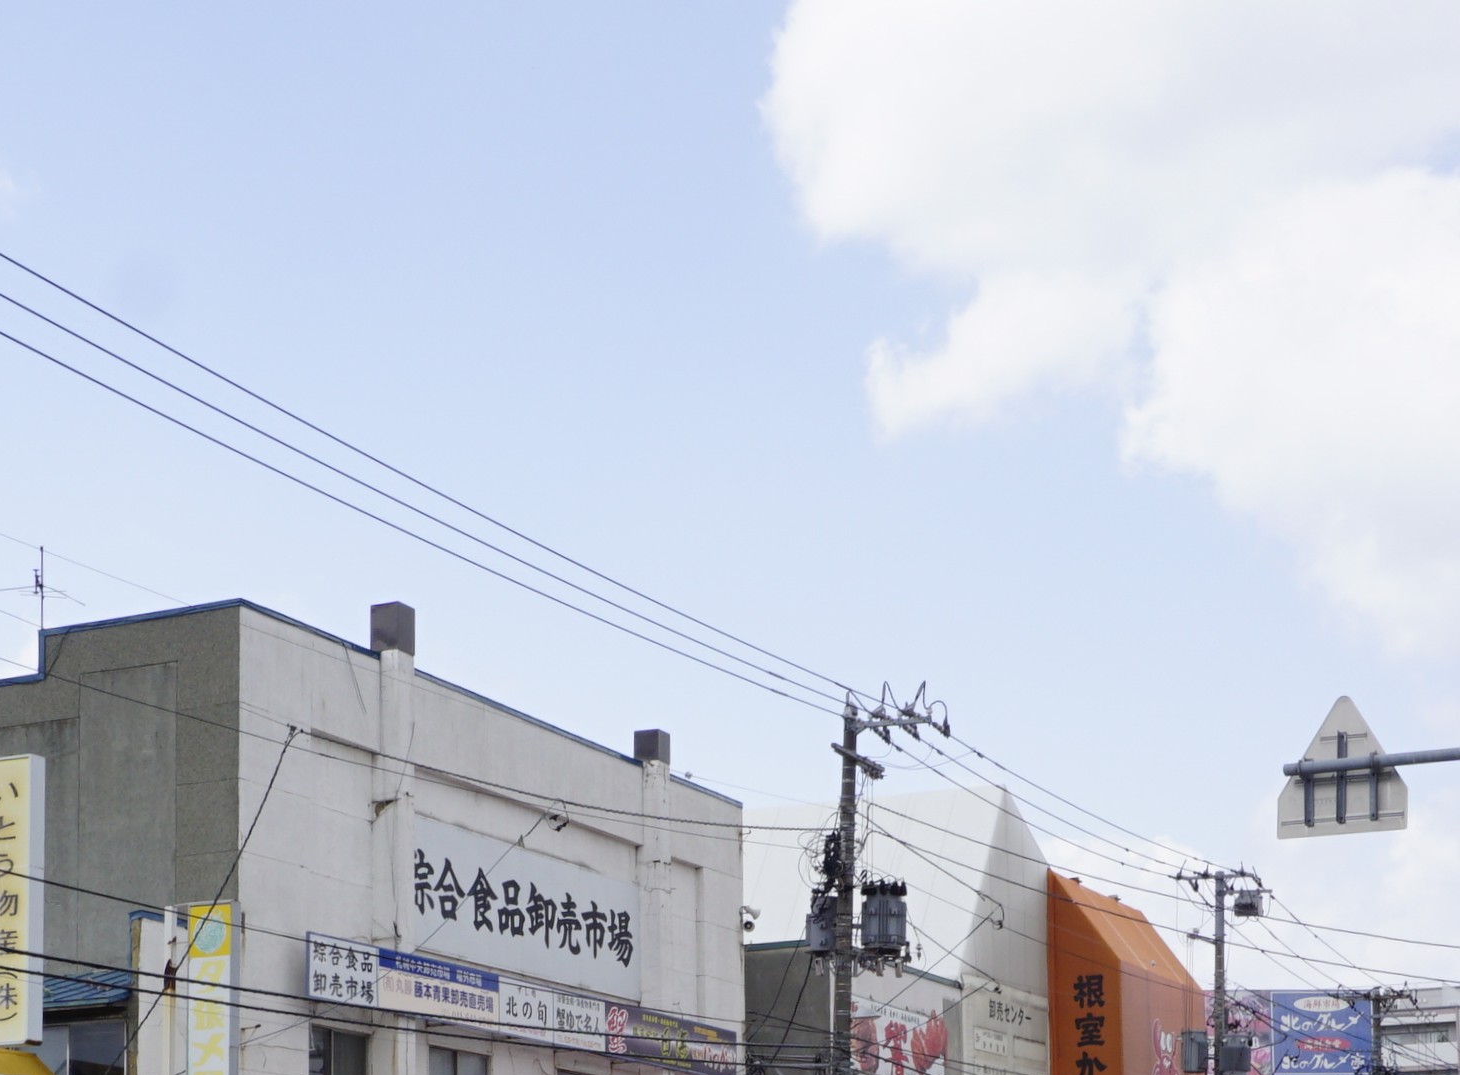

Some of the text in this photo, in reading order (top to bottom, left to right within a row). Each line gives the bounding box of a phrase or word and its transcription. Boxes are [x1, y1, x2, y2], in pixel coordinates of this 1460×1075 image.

[313, 970, 375, 1004] 卸売市場
[506, 996, 548, 1025] 北の旬
[1280, 1011, 1364, 1032] 北のグルメ
